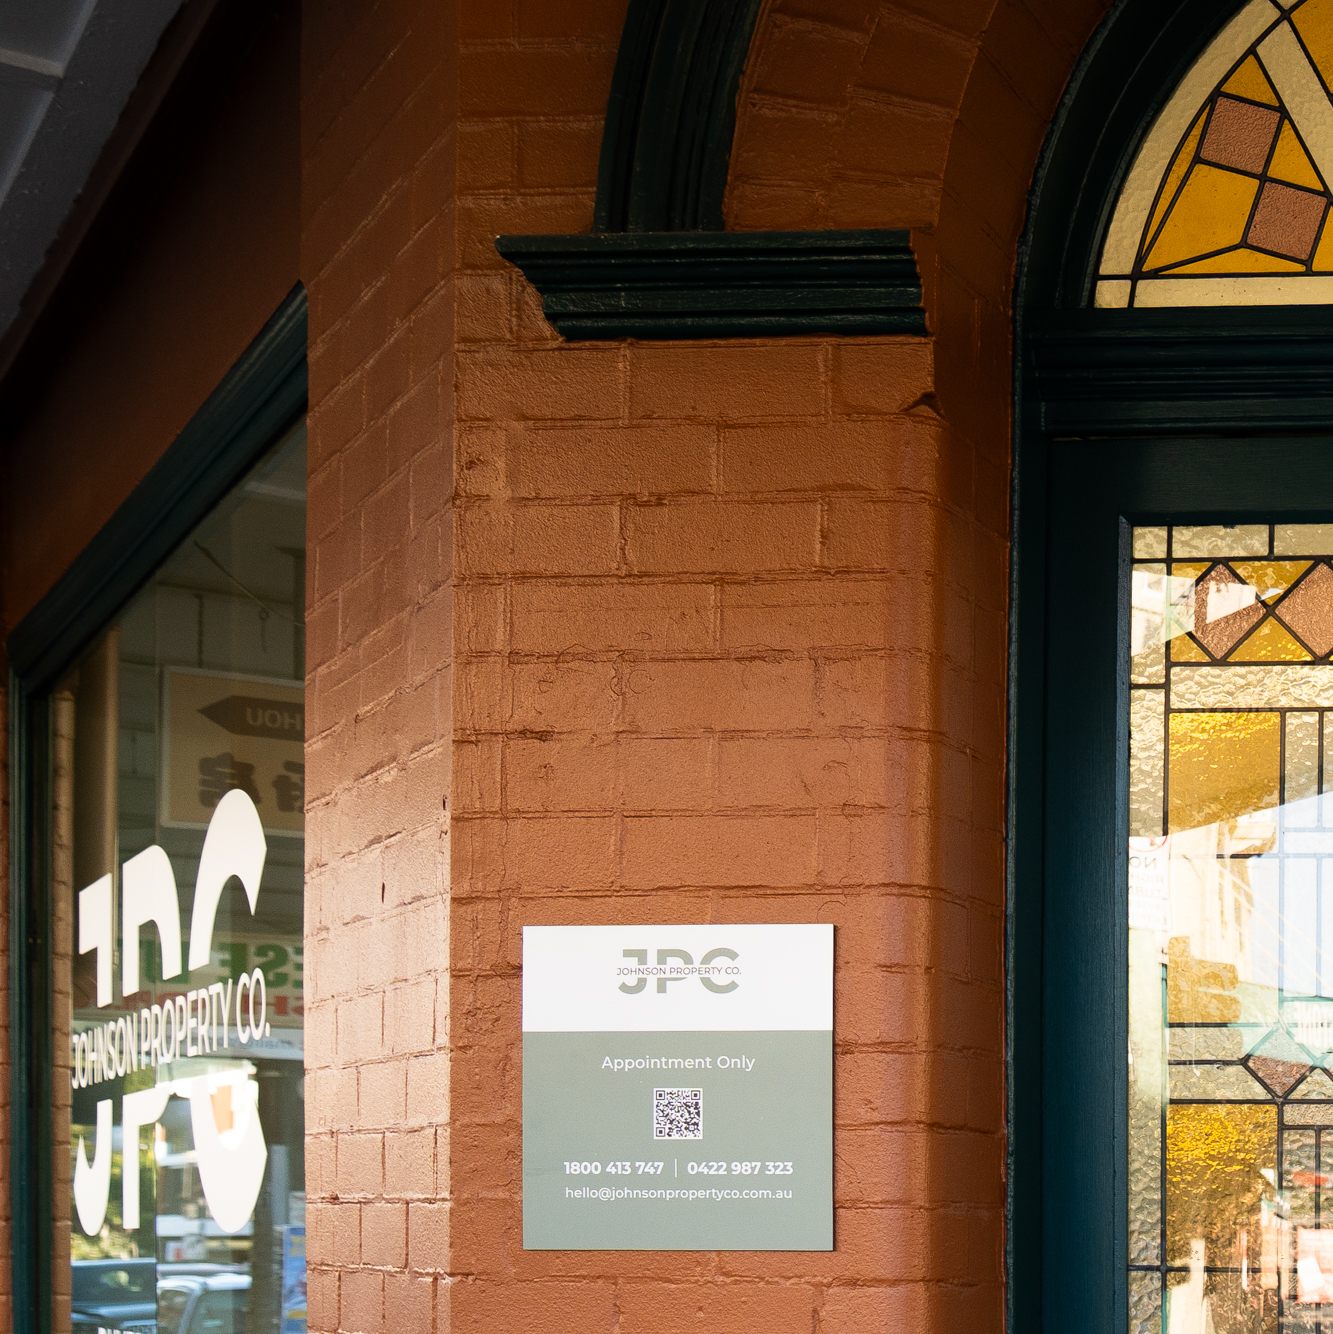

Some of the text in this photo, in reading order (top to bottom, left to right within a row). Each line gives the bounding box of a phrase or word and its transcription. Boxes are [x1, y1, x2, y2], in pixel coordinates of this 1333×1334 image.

[616, 966, 742, 976] JOHNSON PROPERTY CO.
[71, 1012, 138, 1090] JOHNSON
[141, 978, 233, 1070] PROPERTY
[236, 967, 271, 1044] CO.
[601, 1055, 756, 1072] Appointment Only
[563, 1161, 794, 1175] 1800 413 747 0422 987 323
[565, 1186, 793, 1201] hello@johnsonpropertyco.com.au
